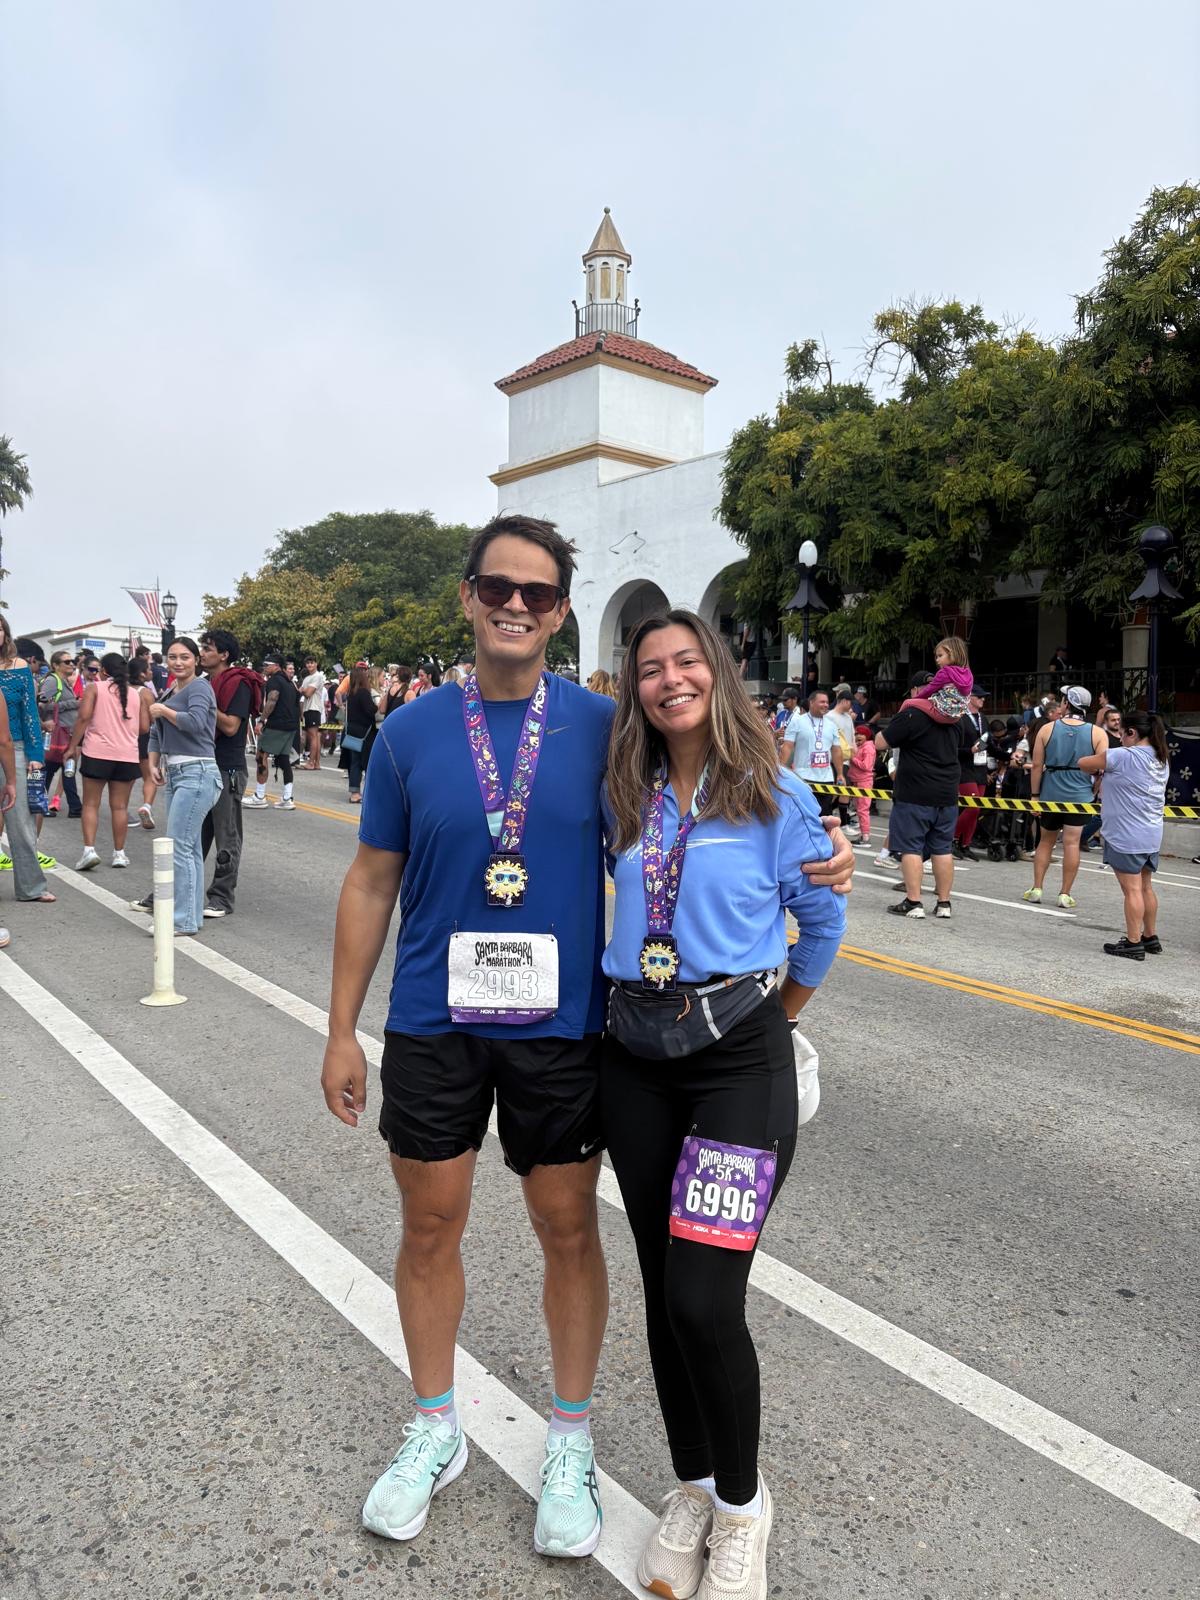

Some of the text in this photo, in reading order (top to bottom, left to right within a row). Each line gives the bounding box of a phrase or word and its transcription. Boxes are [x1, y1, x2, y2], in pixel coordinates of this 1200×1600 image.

[475, 941, 533, 967] SANTA BARBARA
[486, 957, 522, 967] MARATHON
[467, 969, 539, 1001] 2993
[696, 1148, 756, 1185] SANTA BARBARA
[715, 1165, 734, 1181] 5K
[685, 1179, 757, 1223] 6996
